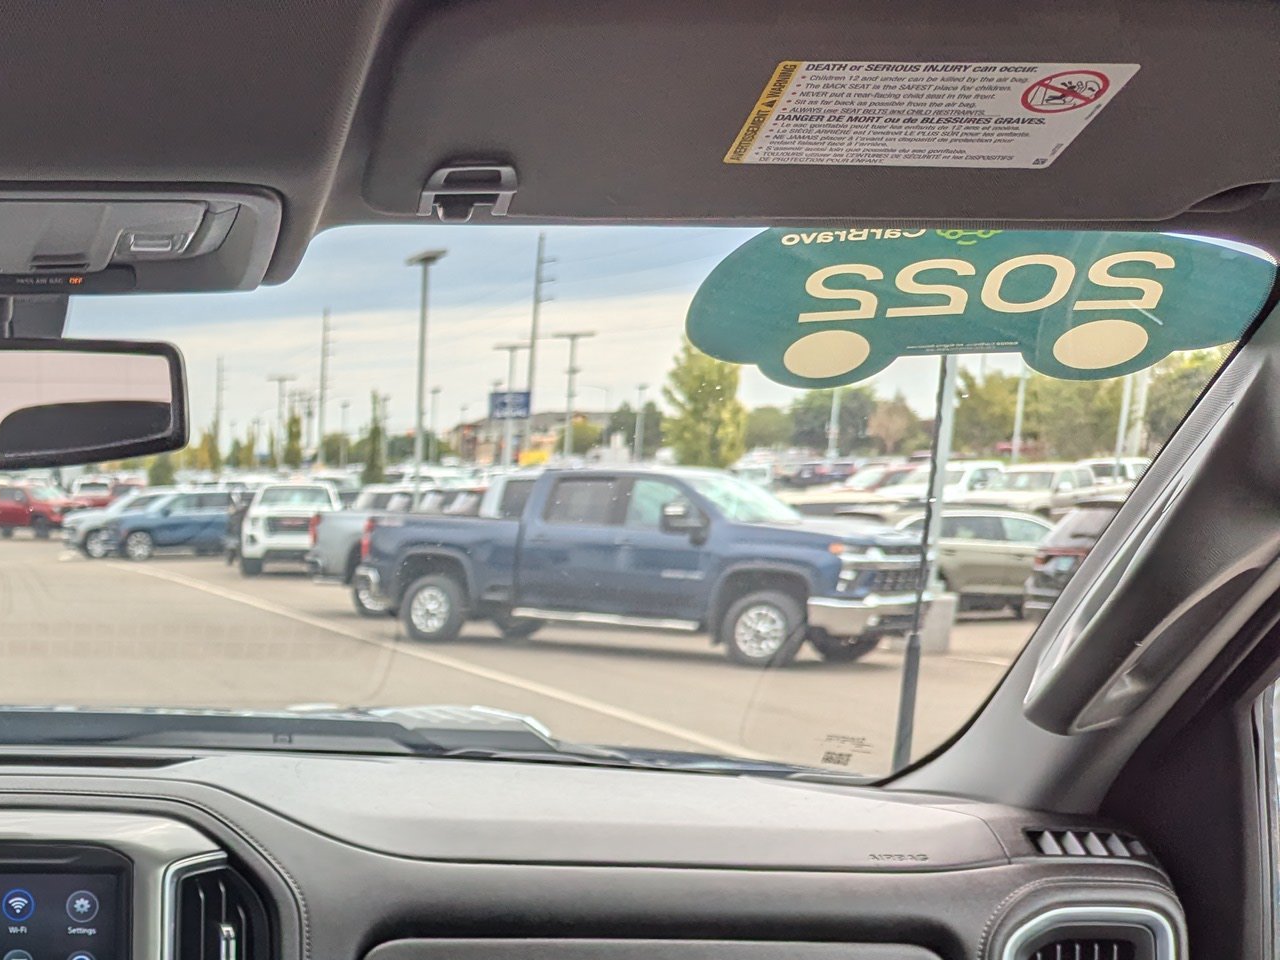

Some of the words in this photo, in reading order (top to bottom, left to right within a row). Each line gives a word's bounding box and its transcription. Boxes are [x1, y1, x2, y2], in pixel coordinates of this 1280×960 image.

[805, 63, 848, 71] DEATH
[864, 64, 921, 72] SERIOUS
[766, 64, 797, 98] WARNING
[729, 110, 771, 160] AVERTISSEMENT
[8, 926, 28, 934] Wi-Fi
[68, 926, 96, 936] Settings
